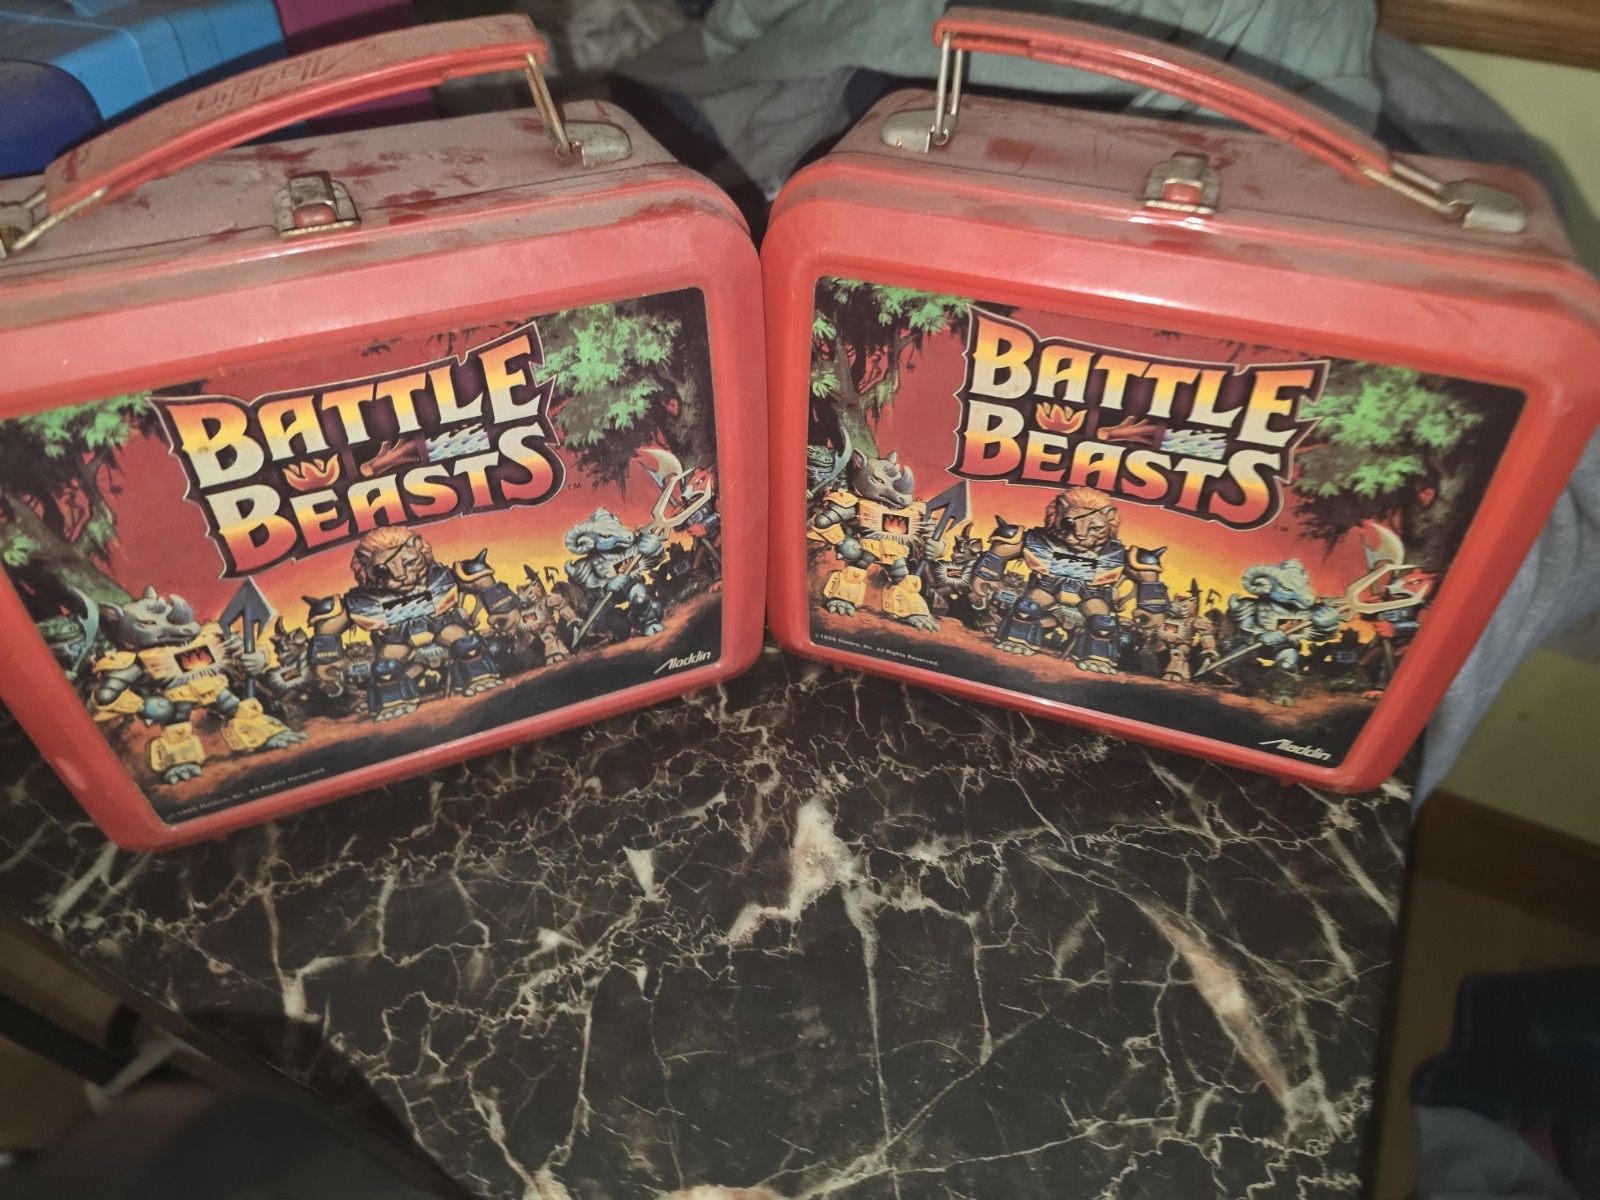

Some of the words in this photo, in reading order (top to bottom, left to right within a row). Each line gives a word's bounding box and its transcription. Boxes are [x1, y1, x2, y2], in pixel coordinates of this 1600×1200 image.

[166, 334, 542, 489] BATTLE
[969, 316, 1315, 447] BATTLE
[206, 422, 553, 573] BEASTS
[567, 482, 582, 491] TM
[963, 400, 1282, 524] BEASTS
[653, 650, 712, 674] Aladdin
[885, 648, 906, 659] Rights
[1258, 738, 1332, 761] Aladdin
